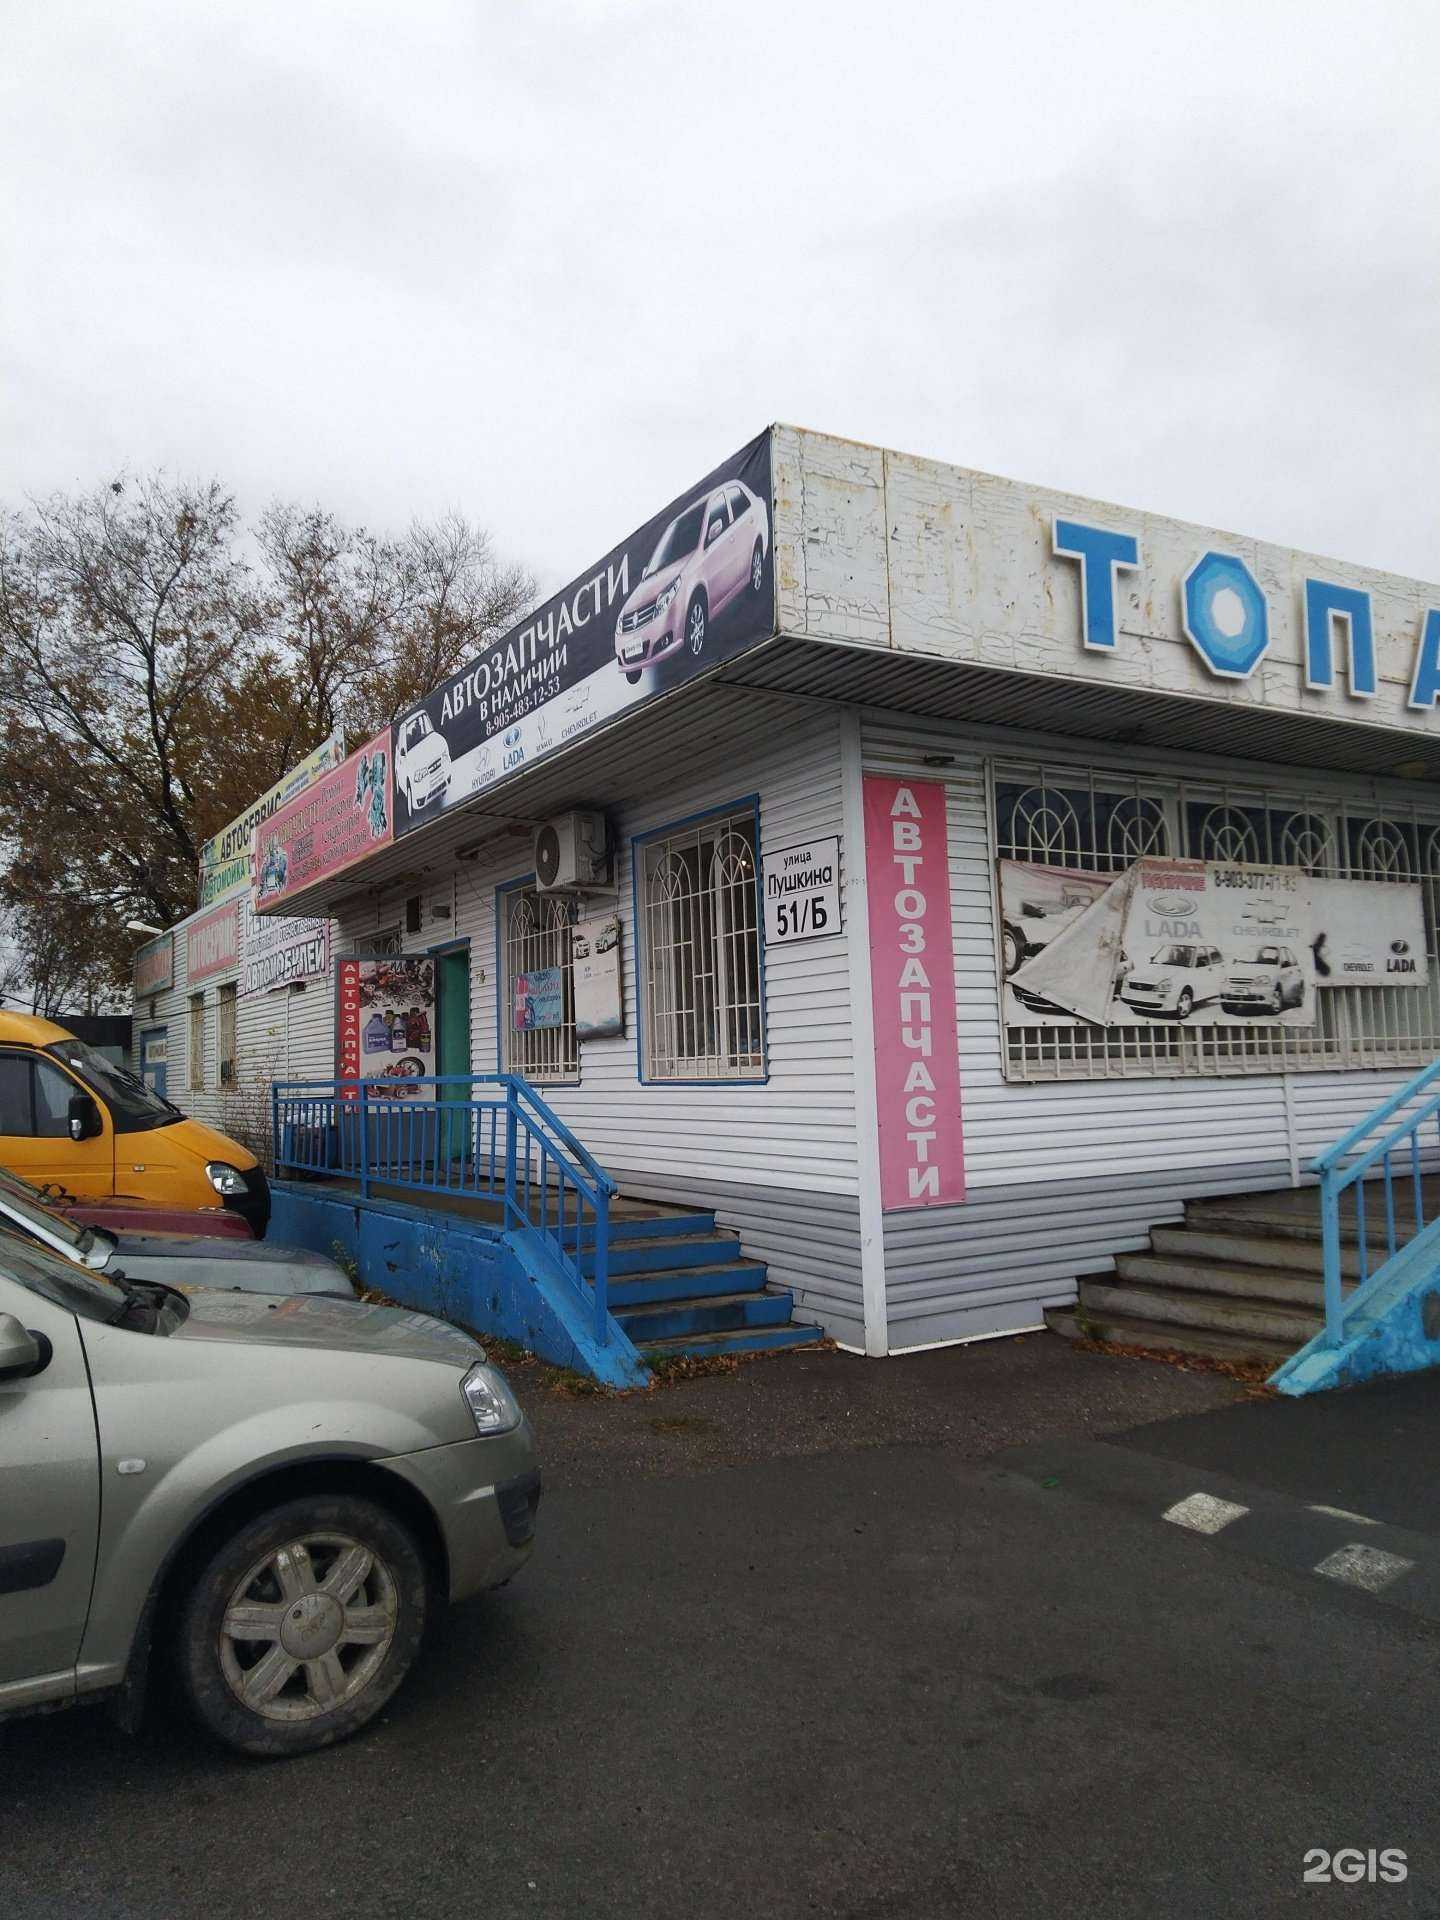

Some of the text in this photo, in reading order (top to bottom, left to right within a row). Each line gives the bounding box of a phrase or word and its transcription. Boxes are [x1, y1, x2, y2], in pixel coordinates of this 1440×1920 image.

[440, 553, 629, 728] АВТОЗАПЧАСТИ
[480, 643, 567, 721] В НАЛИЧИИ
[485, 676, 560, 736] 8-905-483-12-53
[561, 711, 598, 739] CHEVROLET
[503, 746, 525, 771] LADA
[783, 851, 812, 870] улица
[767, 865, 832, 899] Пушкина
[776, 896, 828, 936] 51/Б
[1144, 919, 1203, 939] LADA
[1232, 925, 1300, 938] CHEVROLET
[245, 929, 326, 993] АВТОМОБИЛЕЙ
[1386, 958, 1417, 973] LADA
[890, 787, 941, 1199] АВТОЗАПЧАСТИ
[344, 963, 358, 1114] АВТОЗАПЧАТИ
